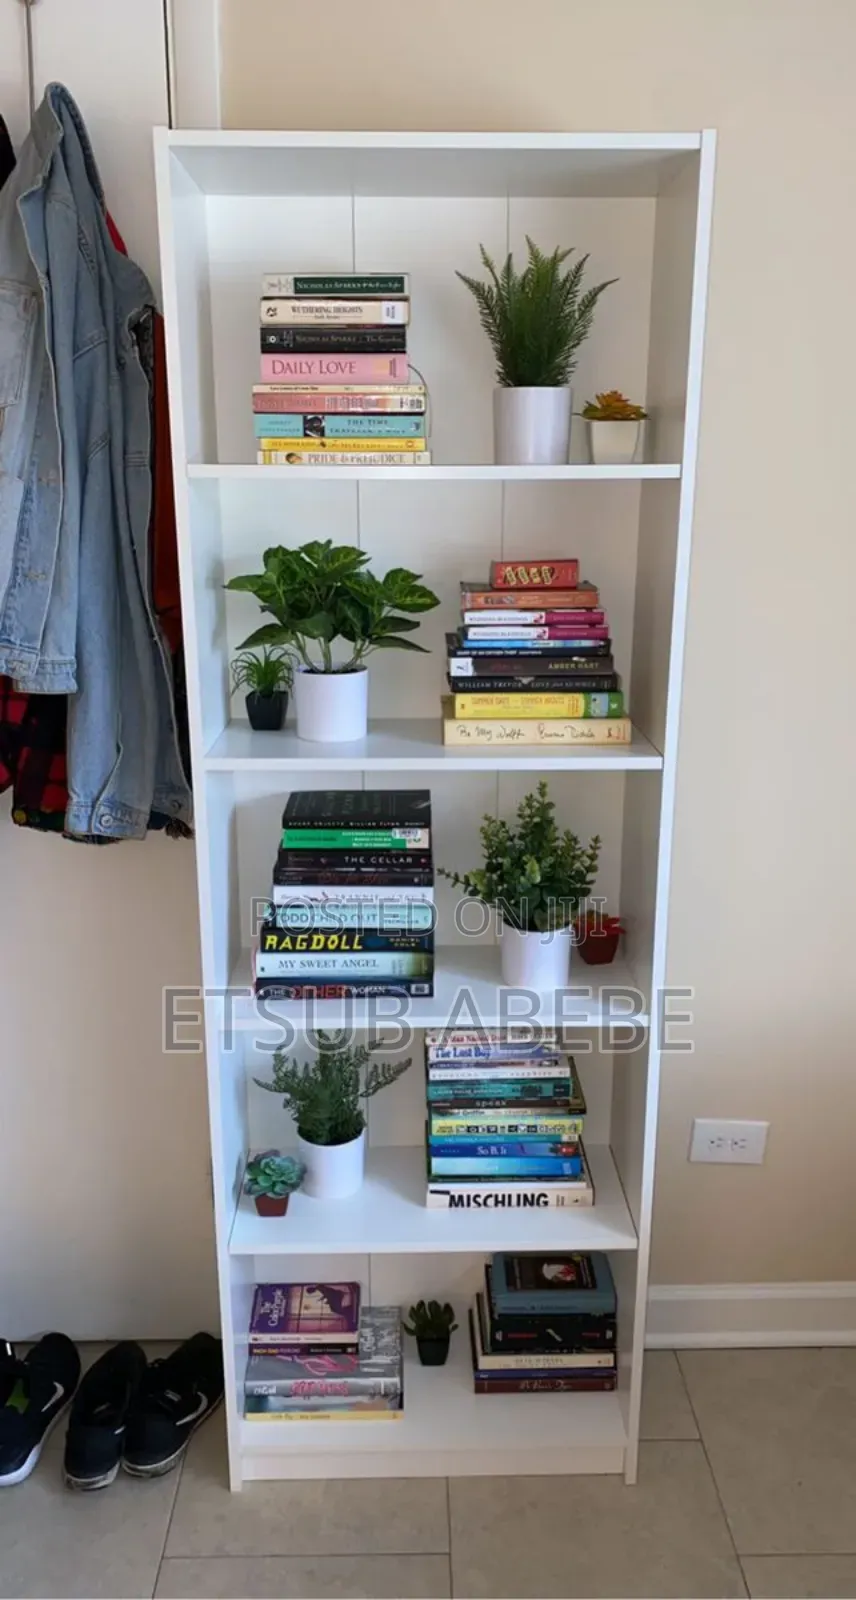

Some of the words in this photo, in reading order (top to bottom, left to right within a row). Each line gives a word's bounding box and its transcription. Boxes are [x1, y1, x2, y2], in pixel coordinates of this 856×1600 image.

[291, 306, 331, 314] WUTHERING
[332, 306, 363, 314] HEIGHTS
[272, 359, 315, 375] DAILY
[319, 359, 357, 375] LOVE
[307, 454, 335, 463] PRIDE
[351, 454, 406, 463] PREJUDICE
[548, 662, 576, 670] AMBER
[344, 856, 366, 864] THE
[370, 856, 413, 864] CELLAR
[281, 914, 308, 924] ODD
[265, 935, 363, 951] RAGDOLL
[278, 959, 296, 969] MY
[299, 959, 337, 969] SWEET
[341, 958, 379, 968] ANGEL
[269, 988, 286, 997] THE
[292, 985, 344, 1000] OTHER
[350, 985, 385, 994] WOMAN
[435, 1047, 451, 1058] The
[453, 1047, 473, 1058] Lost
[474, 1046, 491, 1059] Boy
[476, 1145, 489, 1155] So
[448, 1193, 549, 1209] MISCHLING
